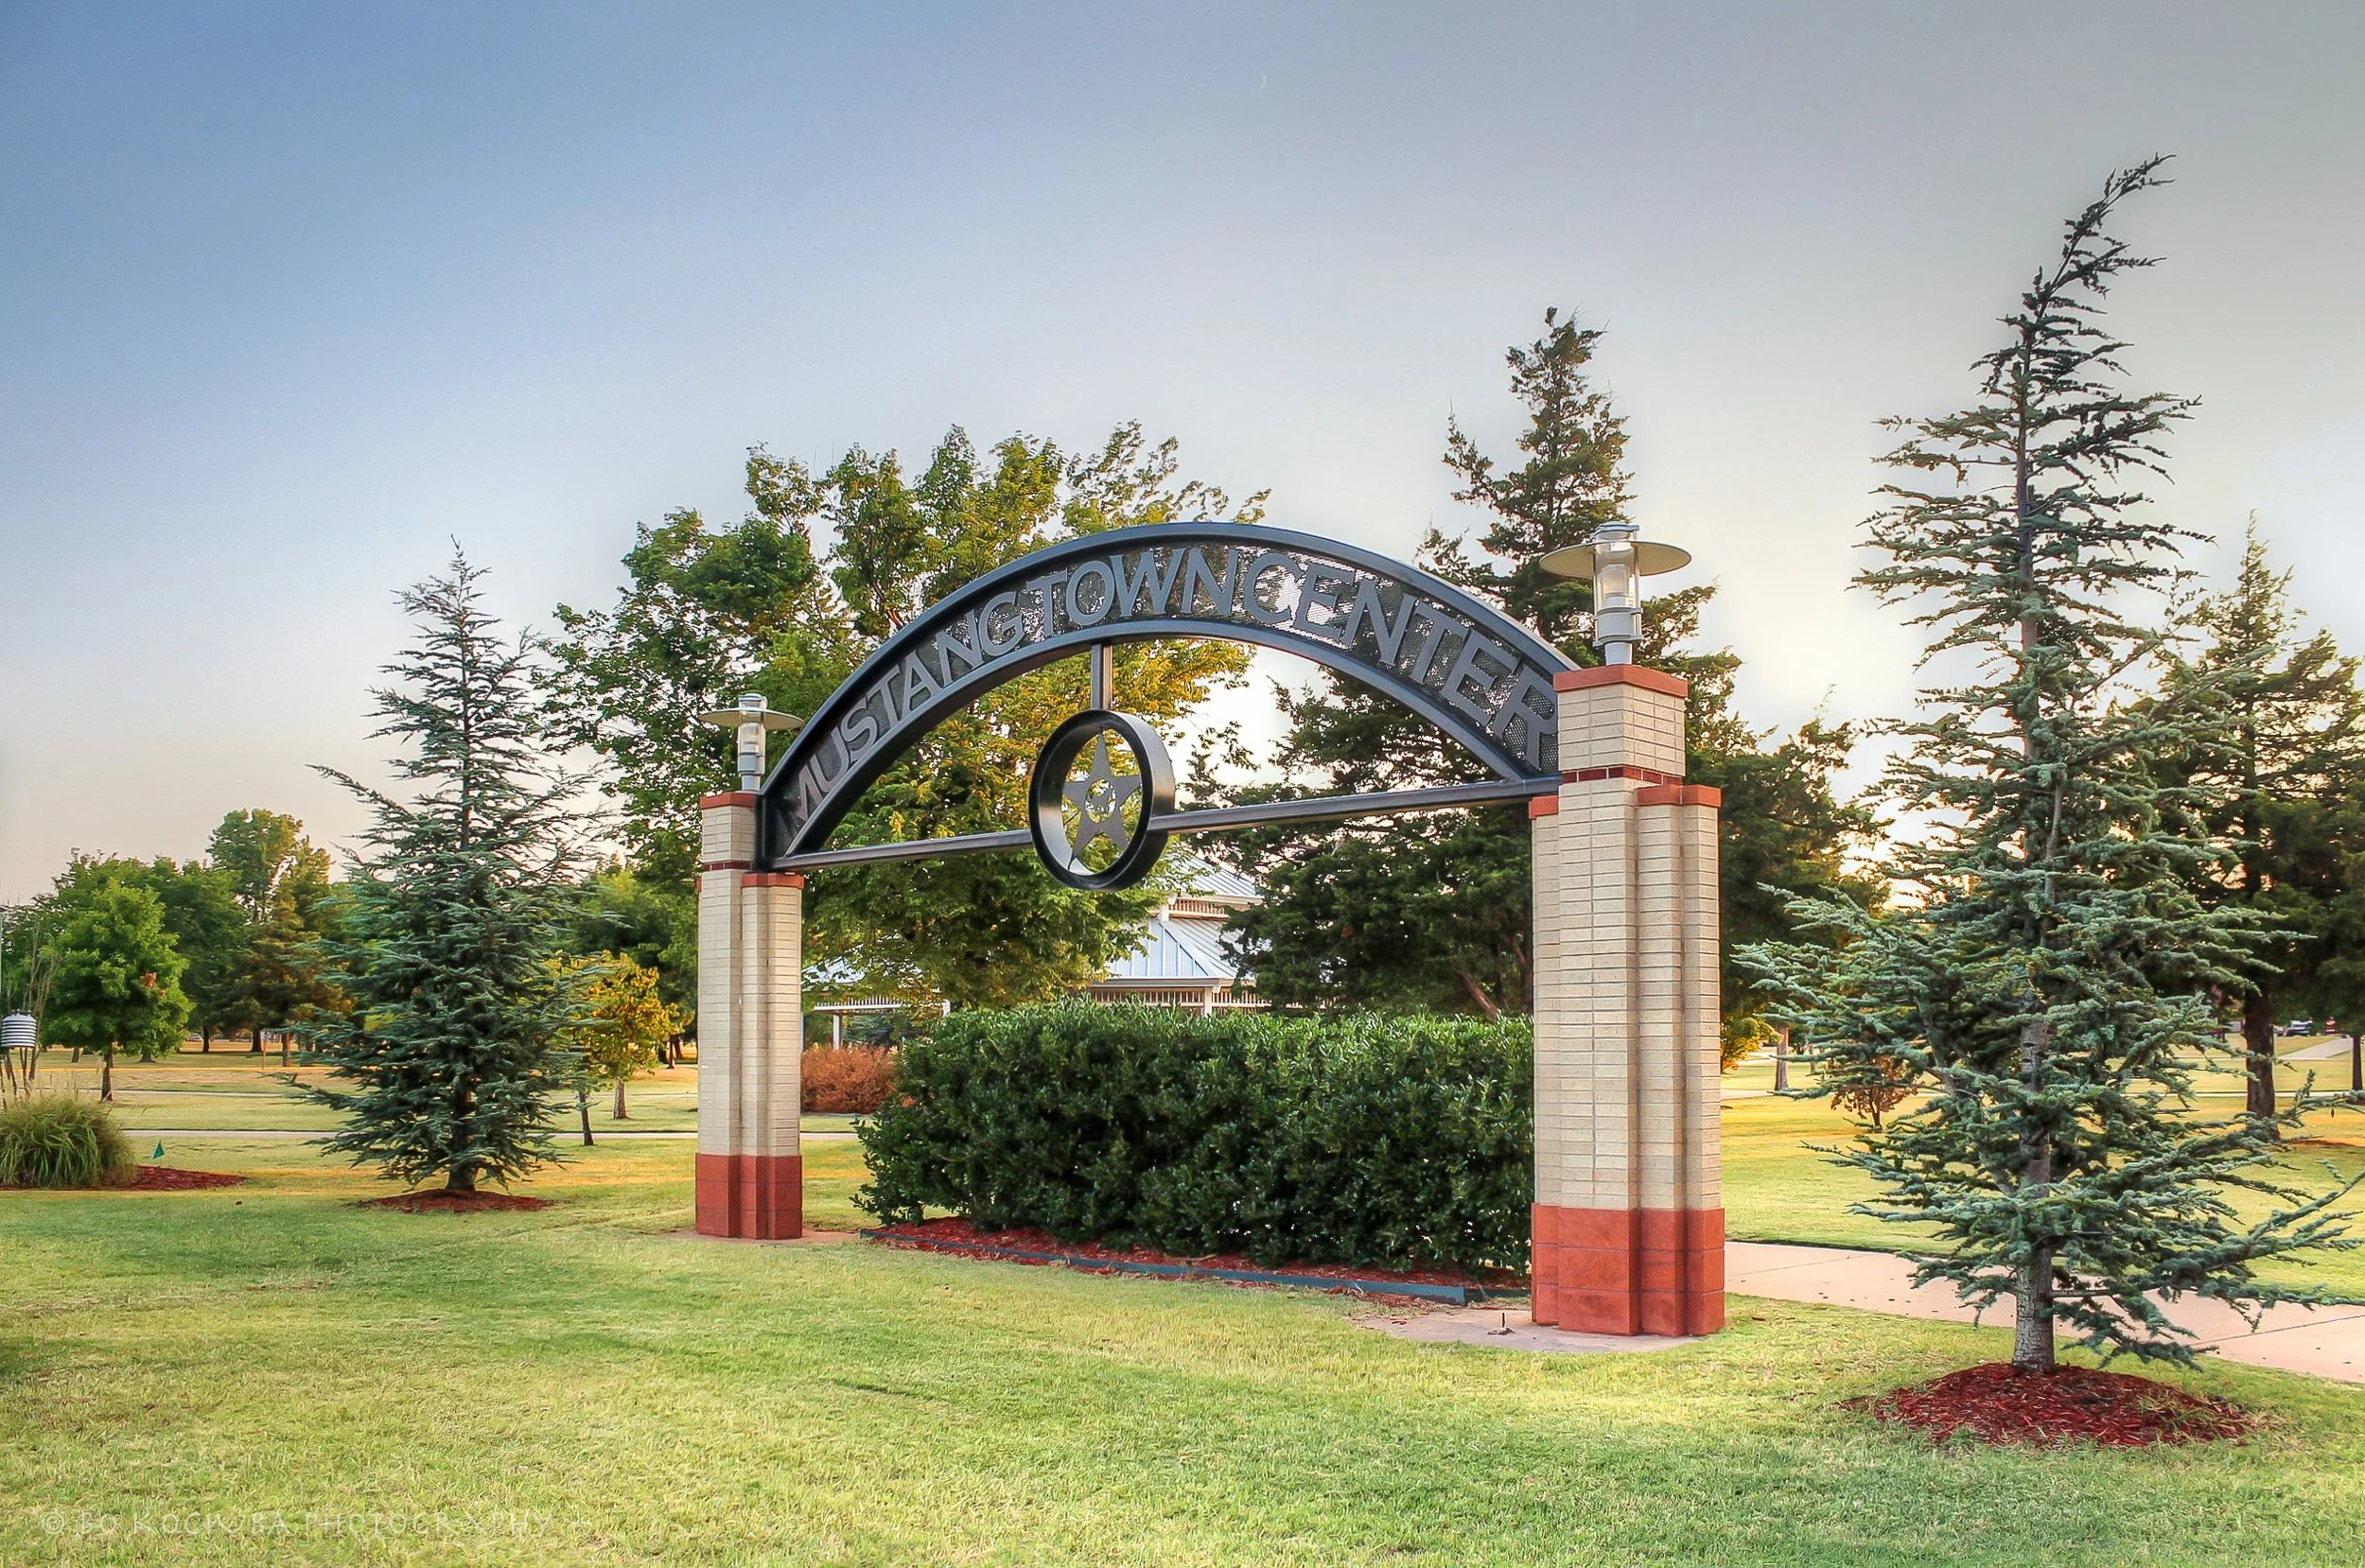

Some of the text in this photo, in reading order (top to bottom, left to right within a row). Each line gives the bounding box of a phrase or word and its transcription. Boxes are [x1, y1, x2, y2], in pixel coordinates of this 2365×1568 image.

[786, 547, 1558, 837] MUSTANG TOWN CENTER
